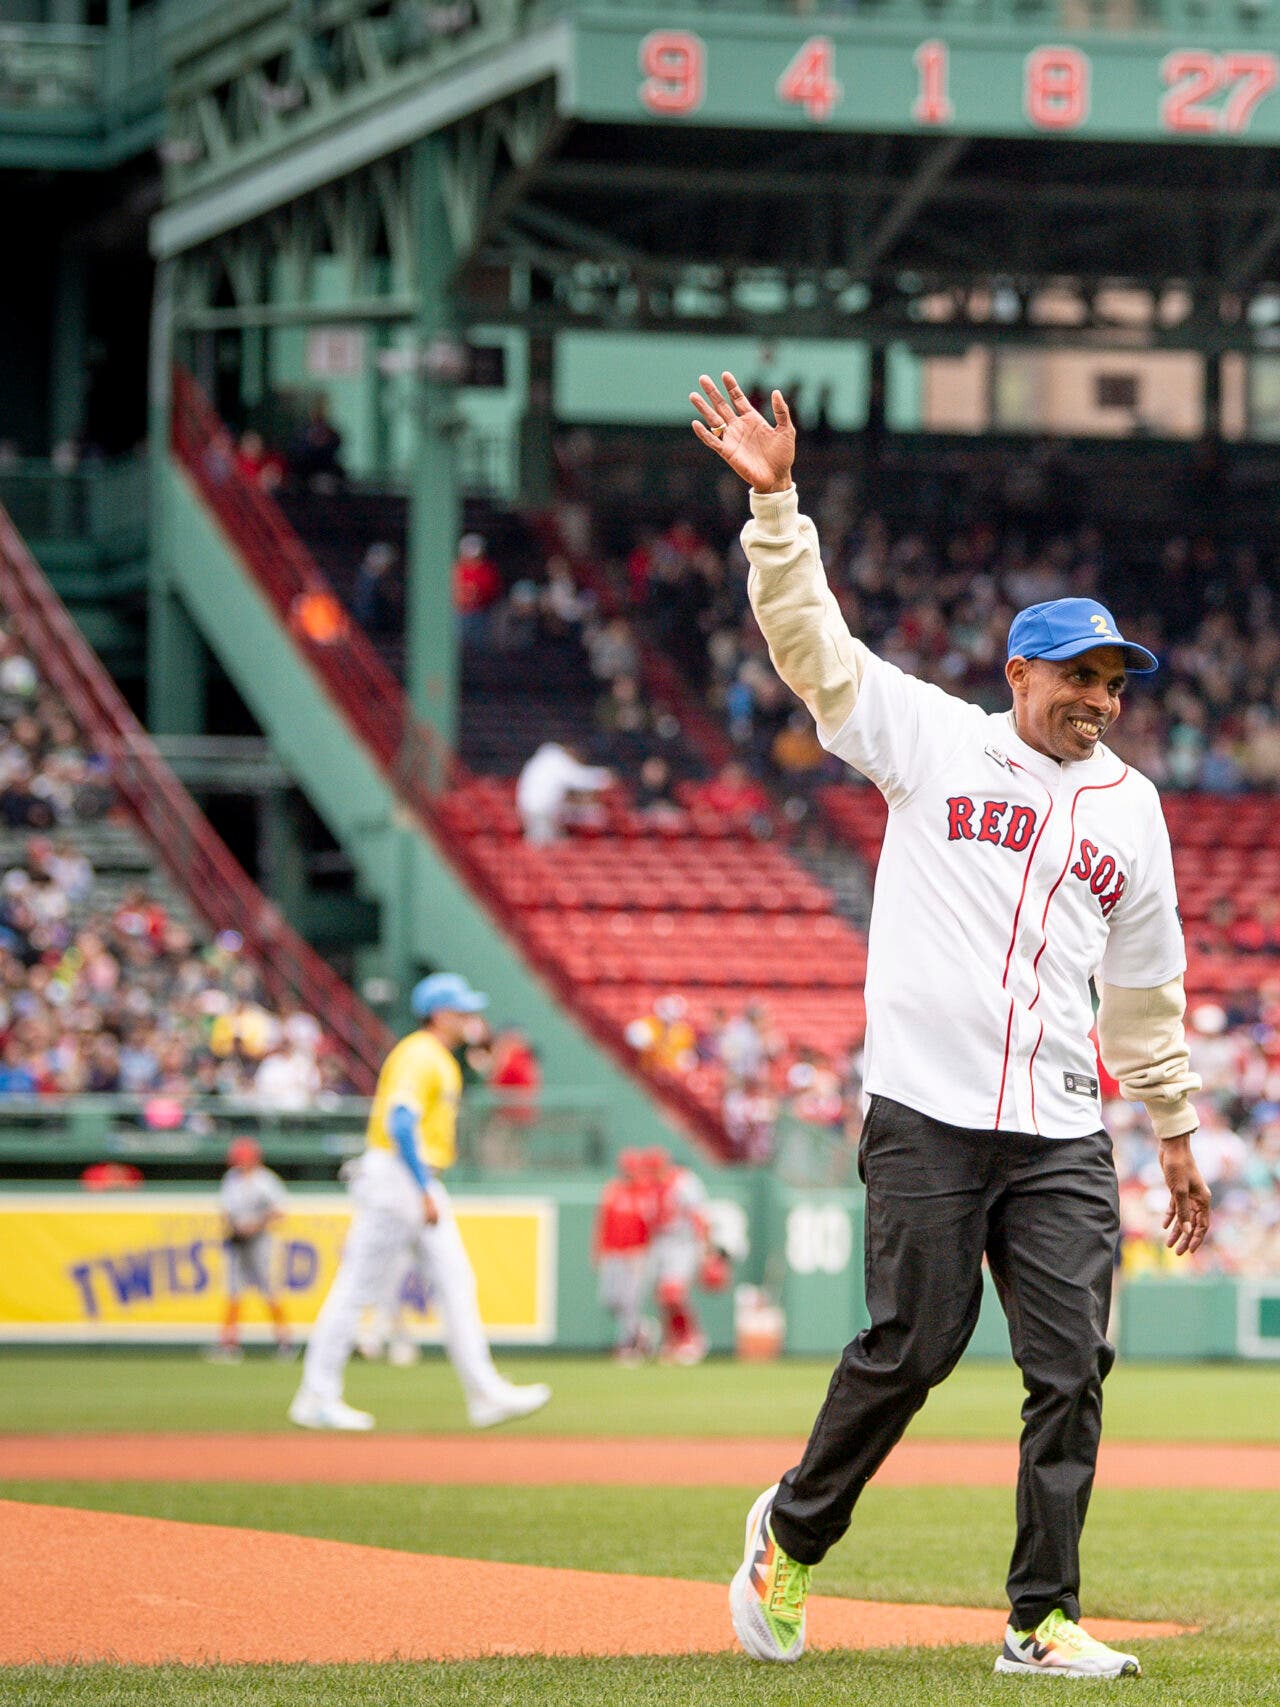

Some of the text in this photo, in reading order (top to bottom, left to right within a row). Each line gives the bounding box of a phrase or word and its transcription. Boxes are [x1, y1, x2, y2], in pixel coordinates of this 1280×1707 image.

[641, 30, 705, 117] 9
[778, 35, 842, 123] 4
[914, 39, 951, 127] 1
[1025, 45, 1089, 132] 8
[1160, 50, 1280, 136] 27
[1090, 614, 1112, 635] 2
[946, 796, 1125, 918] RED SOX
